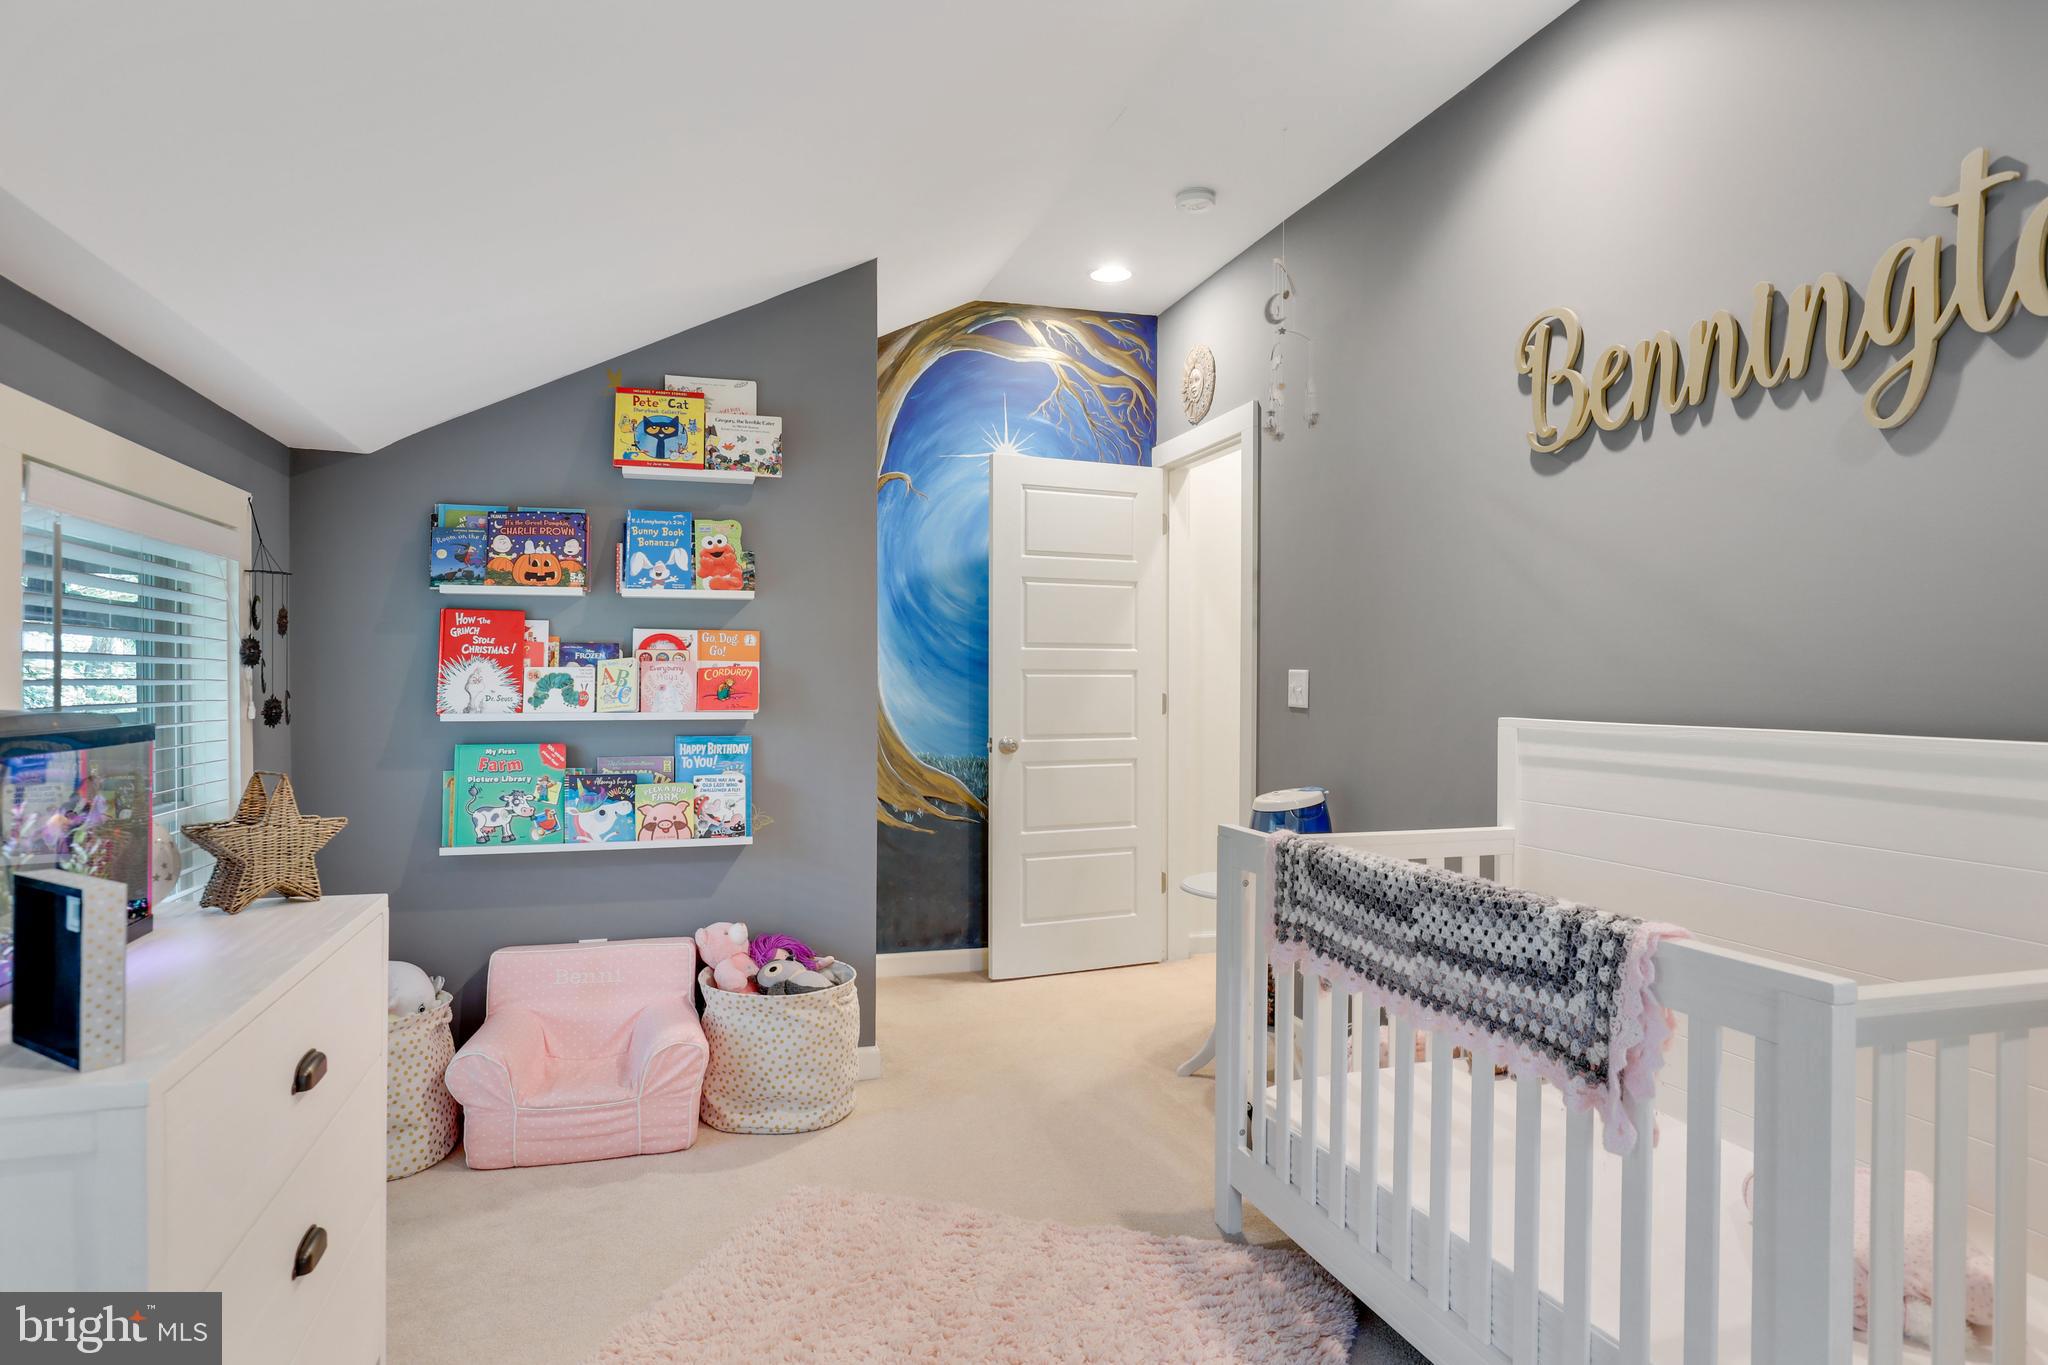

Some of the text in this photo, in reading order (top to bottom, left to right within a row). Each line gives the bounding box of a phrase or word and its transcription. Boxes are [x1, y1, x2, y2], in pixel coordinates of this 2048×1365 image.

[632, 395, 659, 408] Pete
[667, 398, 689, 410] Cat
[500, 527, 575, 536] CHARLIE BROWN
[631, 526, 685, 538] Bunny Book
[435, 535, 457, 543] Room
[637, 537, 679, 547] Bonanza!
[450, 626, 480, 637] GRINCH
[472, 635, 496, 644] STOLE
[574, 651, 606, 660] FROZEN
[709, 645, 727, 657] Go!
[703, 668, 753, 681] CORDUROY
[484, 694, 514, 702] Dr. Seuss
[485, 748, 497, 757] My
[679, 742, 750, 755] HAPPY BIRTHDAY
[477, 757, 523, 772] Farm
[501, 775, 532, 784] Library
[594, 777, 616, 788] Always
[651, 793, 679, 801] FARM
